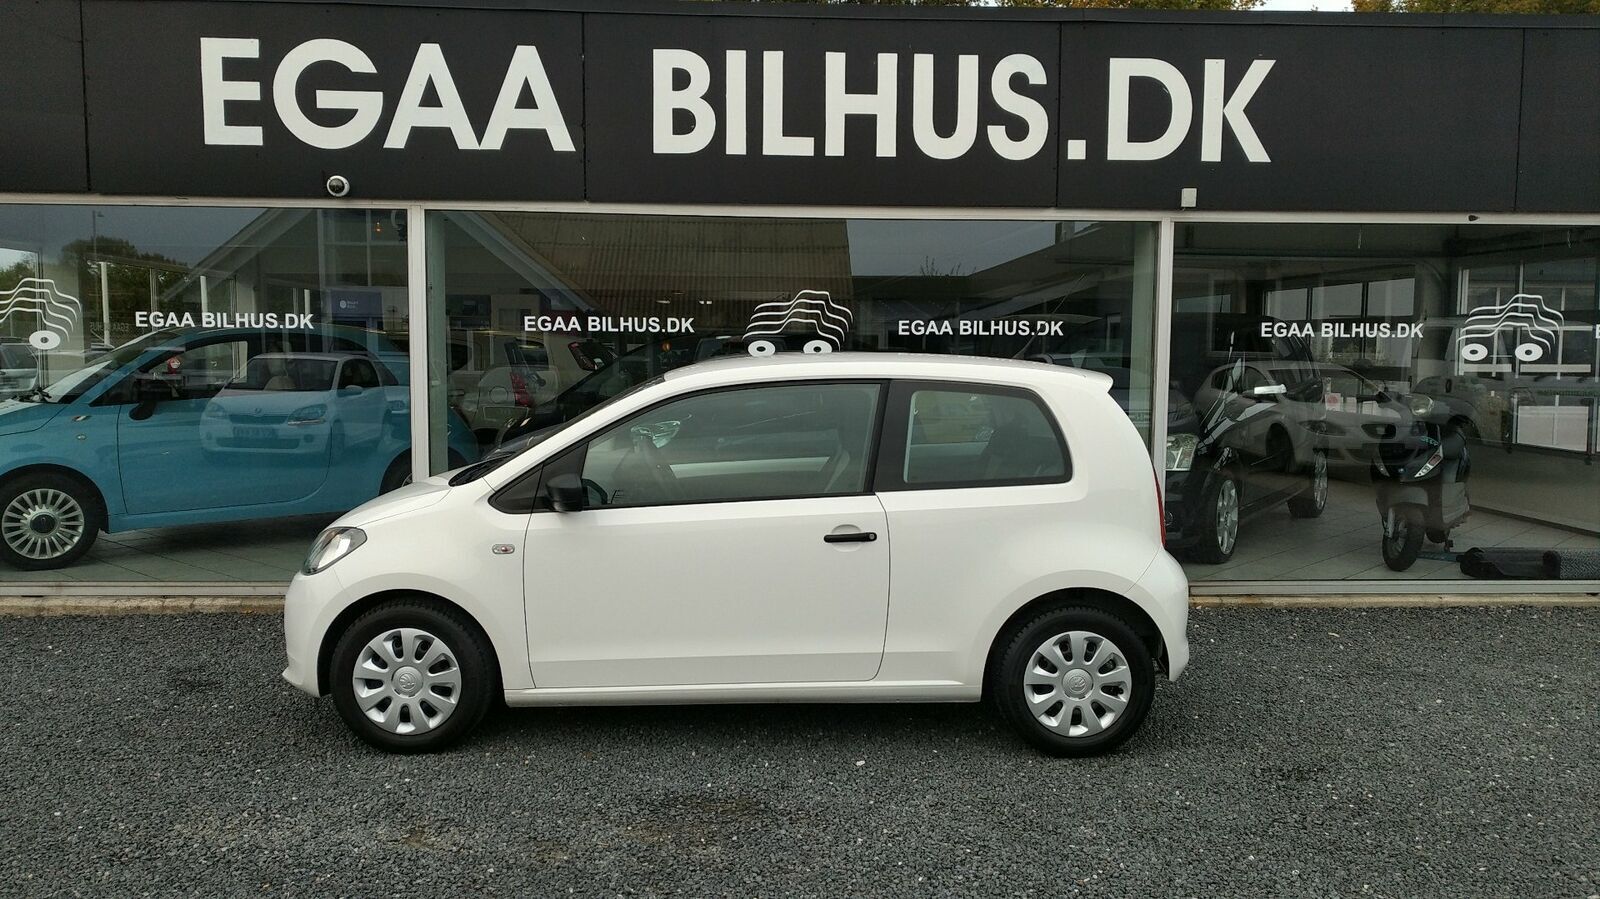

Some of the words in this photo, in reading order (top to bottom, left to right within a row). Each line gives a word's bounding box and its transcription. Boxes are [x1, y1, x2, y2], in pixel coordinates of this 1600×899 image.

[199, 37, 577, 152] EGAA
[651, 48, 1277, 163] BILHUS.DK
[135, 312, 196, 328] EGAA
[201, 312, 314, 330] BILHUS.DK
[523, 315, 583, 333] EGAA
[587, 316, 695, 333] BILHUS.DK
[897, 320, 954, 336] EGAA
[959, 320, 1064, 336] BILHUS.DK
[1261, 322, 1315, 338] EGAA
[1320, 322, 1424, 339] BILHUS.DK
